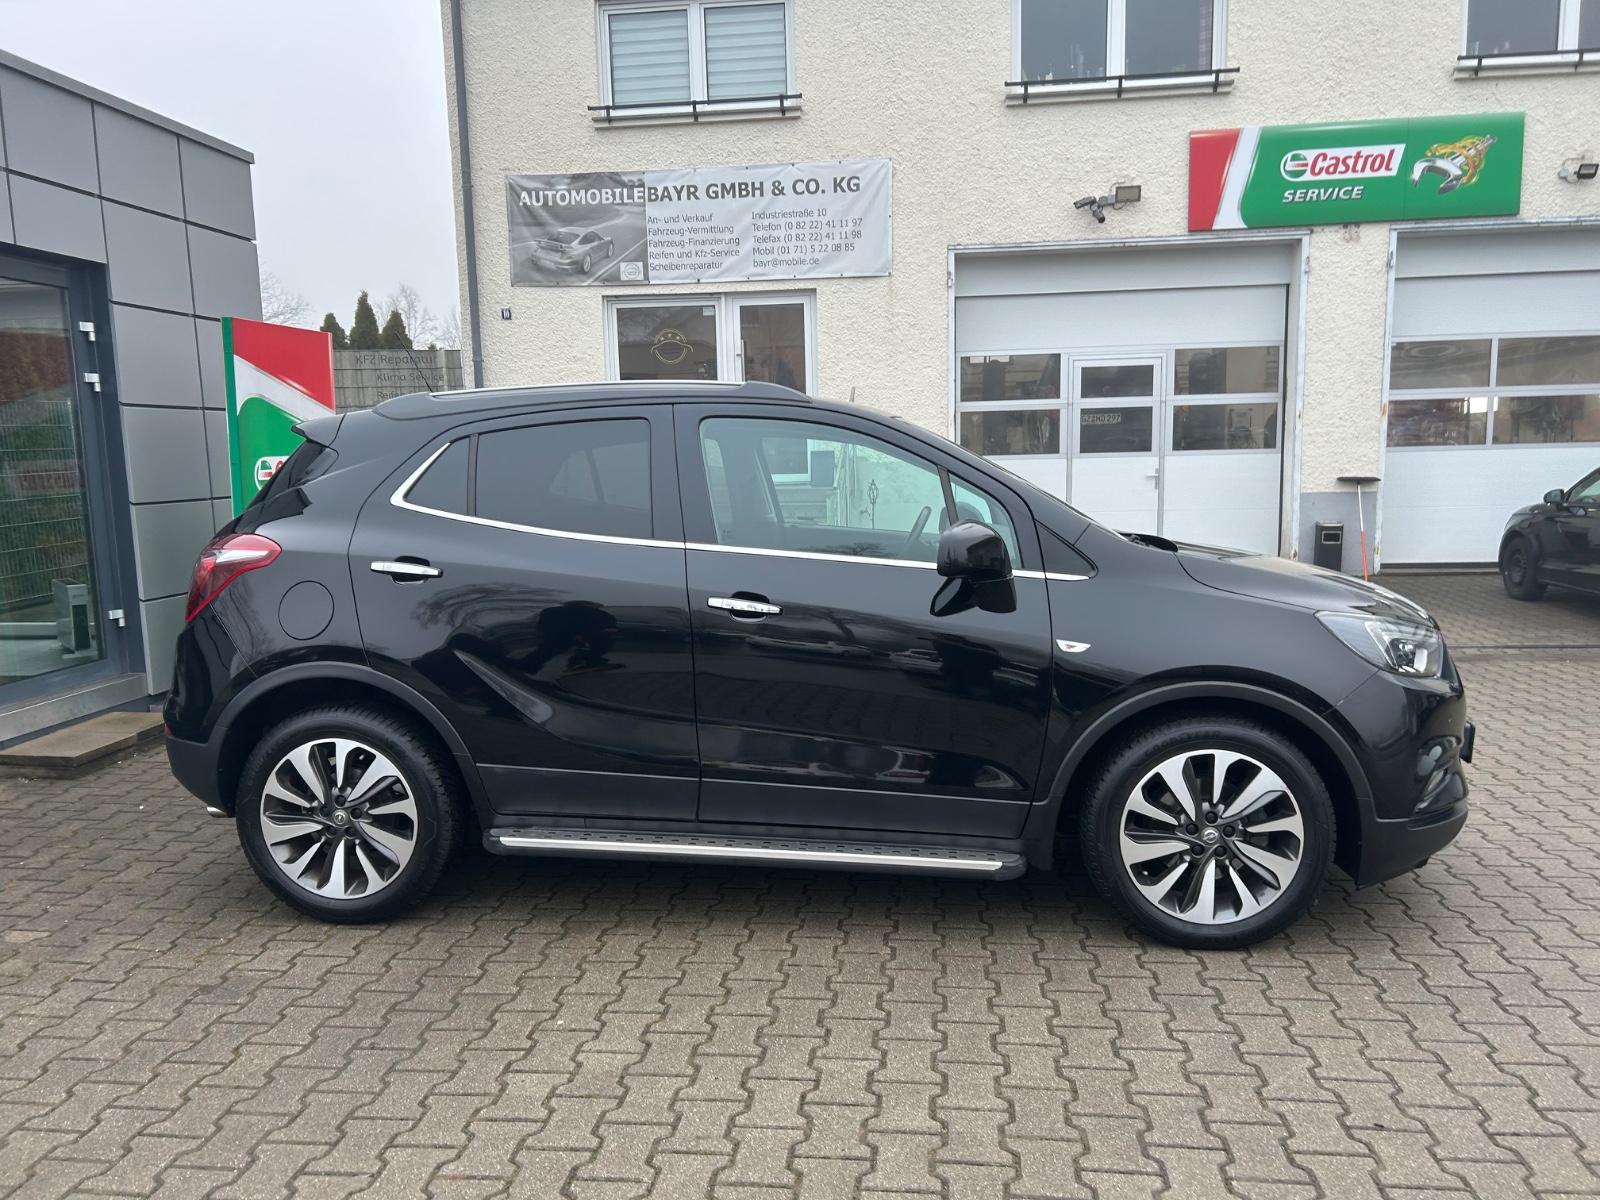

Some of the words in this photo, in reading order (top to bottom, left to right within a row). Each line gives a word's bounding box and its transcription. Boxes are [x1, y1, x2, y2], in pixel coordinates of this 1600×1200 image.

[1309, 148, 1395, 176] Castrol
[519, 187, 644, 206] AUTOMOBILE
[647, 185, 700, 203] BAYR
[705, 181, 765, 200] GMBH
[771, 180, 786, 196] &
[792, 178, 826, 195] CO.
[833, 176, 861, 193] KG
[1282, 186, 1365, 204] SERVICE
[647, 216, 662, 224] An-
[664, 215, 680, 224] und
[682, 212, 714, 223] Verkauf
[751, 208, 814, 220] Industriestraße
[816, 207, 827, 217] 10
[648, 225, 734, 237] Fahrzeug-Vermittlung
[752, 222, 782, 232] Telefon
[784, 221, 793, 232] (0
[796, 220, 806, 230] 82
[809, 220, 823, 231] 22)
[826, 219, 836, 228] 41
[840, 219, 849, 228] 11
[852, 217, 863, 228] 97
[648, 237, 740, 248] Fahrzeug-Finanzierung
[752, 234, 782, 244] Telefax
[783, 233, 793, 244] (0
[795, 232, 806, 242] 82
[808, 231, 823, 242] 22)
[825, 231, 835, 240] 41
[839, 231, 848, 240] 11
[851, 230, 862, 239] 98
[649, 250, 675, 260] Reifen
[676, 250, 692, 259] und
[695, 248, 740, 258] Kfz-Service
[752, 246, 775, 256] Mobil
[777, 245, 790, 256] (01
[794, 245, 807, 256] 71)
[810, 244, 816, 253] 5
[818, 243, 829, 253] 22
[831, 243, 842, 252] 08
[844, 242, 855, 252] 85
[649, 261, 724, 271] Scheibenreparatur
[753, 256, 820, 269] bayr@mobile.de
